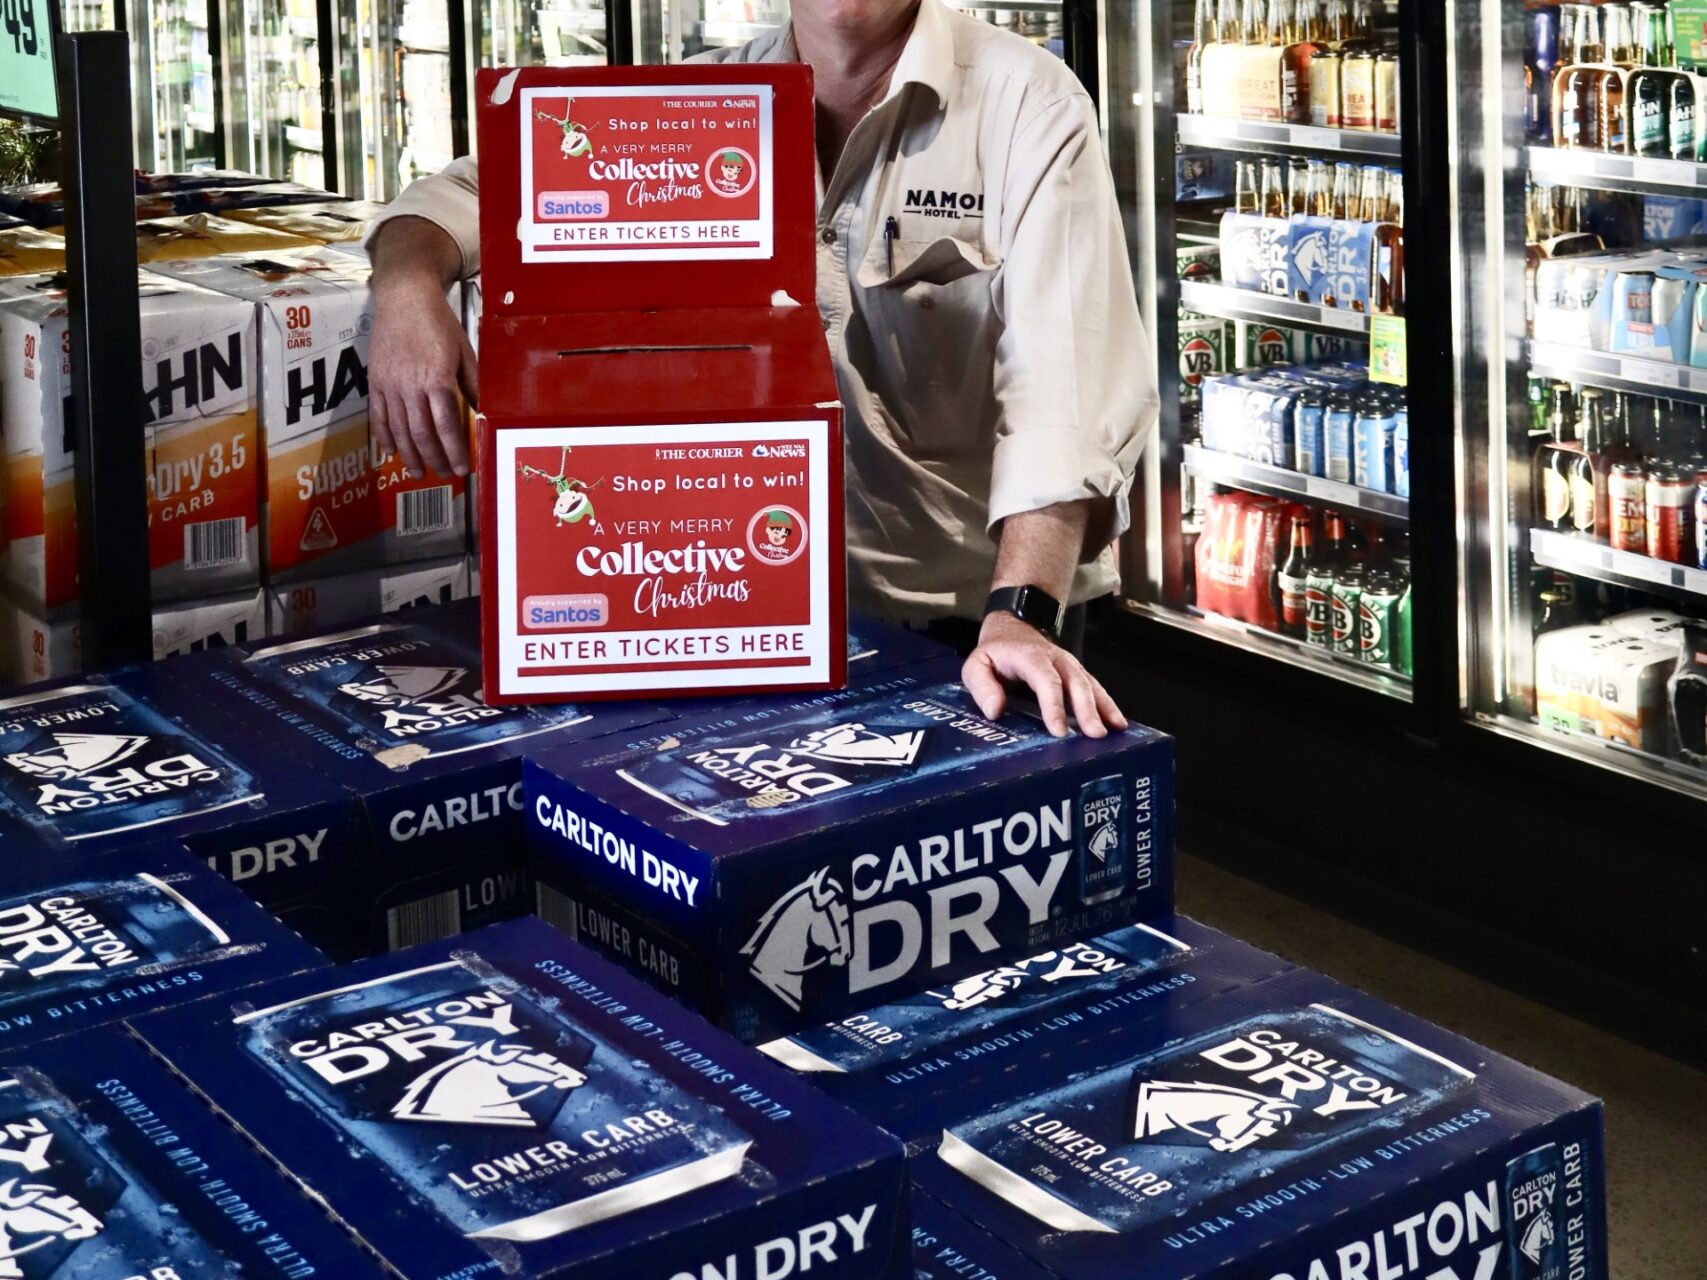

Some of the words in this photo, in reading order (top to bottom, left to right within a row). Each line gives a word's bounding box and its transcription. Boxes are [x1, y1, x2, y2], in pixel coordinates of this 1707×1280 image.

[666, 100, 682, 108] THE
[608, 118, 650, 133] Shop
[656, 117, 695, 130] local
[702, 118, 716, 129] to
[725, 117, 756, 130] win!
[600, 145, 608, 154] A
[613, 144, 645, 154] VERY
[650, 143, 693, 154] MERRY
[588, 157, 700, 182] Collective
[544, 200, 603, 216] Santos
[627, 179, 704, 208] Christmas
[924, 208, 961, 219] HOTEL
[553, 227, 609, 241] ENTER
[616, 226, 691, 240] TICKETS
[698, 225, 741, 239] HERE
[286, 305, 311, 330] 30
[24, 334, 35, 360] 30
[287, 337, 313, 350] CANS
[1258, 343, 1284, 363] VB
[1315, 336, 1342, 354] VB
[1185, 352, 1212, 373] VB
[286, 345, 370, 426] HA
[209, 433, 247, 480] 3.5
[661, 449, 687, 460] THE
[688, 447, 744, 459] COURIER
[769, 446, 806, 458] News
[296, 444, 369, 502] Super
[332, 483, 370, 510] LOW
[377, 467, 411, 491] CAR
[612, 476, 666, 494] Shop
[675, 474, 726, 490] local
[733, 474, 754, 489] to
[763, 471, 805, 488] win!
[161, 488, 215, 521] CARB
[593, 522, 604, 536] A
[613, 521, 662, 535] VERY
[670, 518, 733, 534] MERRY
[576, 540, 746, 577] Collective
[291, 587, 317, 611] 30
[633, 573, 750, 617] Christmas
[530, 605, 601, 624] Santos
[356, 640, 431, 662] LOWER
[524, 640, 607, 661] ENTER
[618, 634, 730, 657] TICKETS
[740, 632, 805, 653] HERE
[287, 657, 348, 675] CARB
[1551, 663, 1619, 704] travla
[793, 687, 862, 712] SMOOTH
[867, 677, 918, 694] ULTRA
[36, 704, 121, 728] LOWER
[743, 708, 781, 723] LOW
[902, 700, 957, 725] CARB
[297, 723, 364, 760] BITTERNESS
[627, 719, 736, 751] BITTERNESS
[949, 719, 1019, 747] LOWER
[37, 754, 211, 806] DRY
[686, 751, 800, 803] CARLTON
[714, 743, 853, 797] DRY
[41, 770, 220, 815] CARLTON
[1083, 795, 1122, 813] CARLTON
[1136, 775, 1151, 825] CARB
[390, 783, 525, 841] CARLTO
[1084, 803, 1122, 829] DRY
[233, 829, 328, 882] DRY
[536, 795, 636, 876] CARLTON
[643, 849, 699, 907] DRY
[851, 799, 1072, 903] CARLTON
[1136, 827, 1152, 891] LOWER
[0, 903, 102, 977] DRY
[40, 896, 140, 967] CARLTON
[848, 848, 1074, 995] DRY
[580, 903, 633, 957] LOWER
[639, 937, 680, 987] CARB
[47, 971, 204, 1018] BITTERNESS
[289, 991, 506, 1058] CARLTON
[534, 958, 627, 1016] BITTERNESS
[620, 1013, 655, 1038] LOW
[662, 1039, 735, 1085] SMOOTH
[729, 1082, 792, 1121] ULTRA
[842, 1015, 903, 1045] CARB
[885, 1057, 951, 1085] ULTRA
[953, 1028, 1033, 1061] SMOOTH
[1045, 1010, 1084, 1032] LOW
[1087, 972, 1198, 1017] BITTERNESS
[303, 1003, 520, 1085] DRY
[1199, 1037, 1383, 1117] DRY
[1247, 1028, 1408, 1108] CARLTON
[448, 1140, 580, 1192] LOWER
[581, 1108, 676, 1150] CARB
[1006, 1122, 1034, 1140] ULTRA
[1033, 1136, 1070, 1161] SMOOTH
[1070, 1157, 1092, 1174] LOW
[1089, 1170, 1146, 1203] BITTERNESS
[1019, 1111, 1107, 1162] LOWER
[1099, 1156, 1173, 1198] CARB
[96, 1078, 181, 1146] BITTERNESS
[165, 1147, 209, 1175] LOW
[200, 1179, 268, 1233] SMOOTH
[256, 1233, 316, 1280] ULTRA
[469, 1176, 516, 1199] ULTRA
[516, 1162, 572, 1186] SMOOTH
[577, 1148, 606, 1167] LOW
[582, 1170, 607, 1187] 375
[1163, 1221, 1232, 1251] ULTRA
[1236, 1179, 1321, 1220] SMOOTH
[1329, 1153, 1374, 1181] LOW
[1379, 1107, 1492, 1160] BITTERNESS
[1511, 1170, 1557, 1200] CARLTON
[1563, 1141, 1582, 1207] CARB
[1513, 1184, 1557, 1222] DRY
[754, 1203, 878, 1280] DRY
